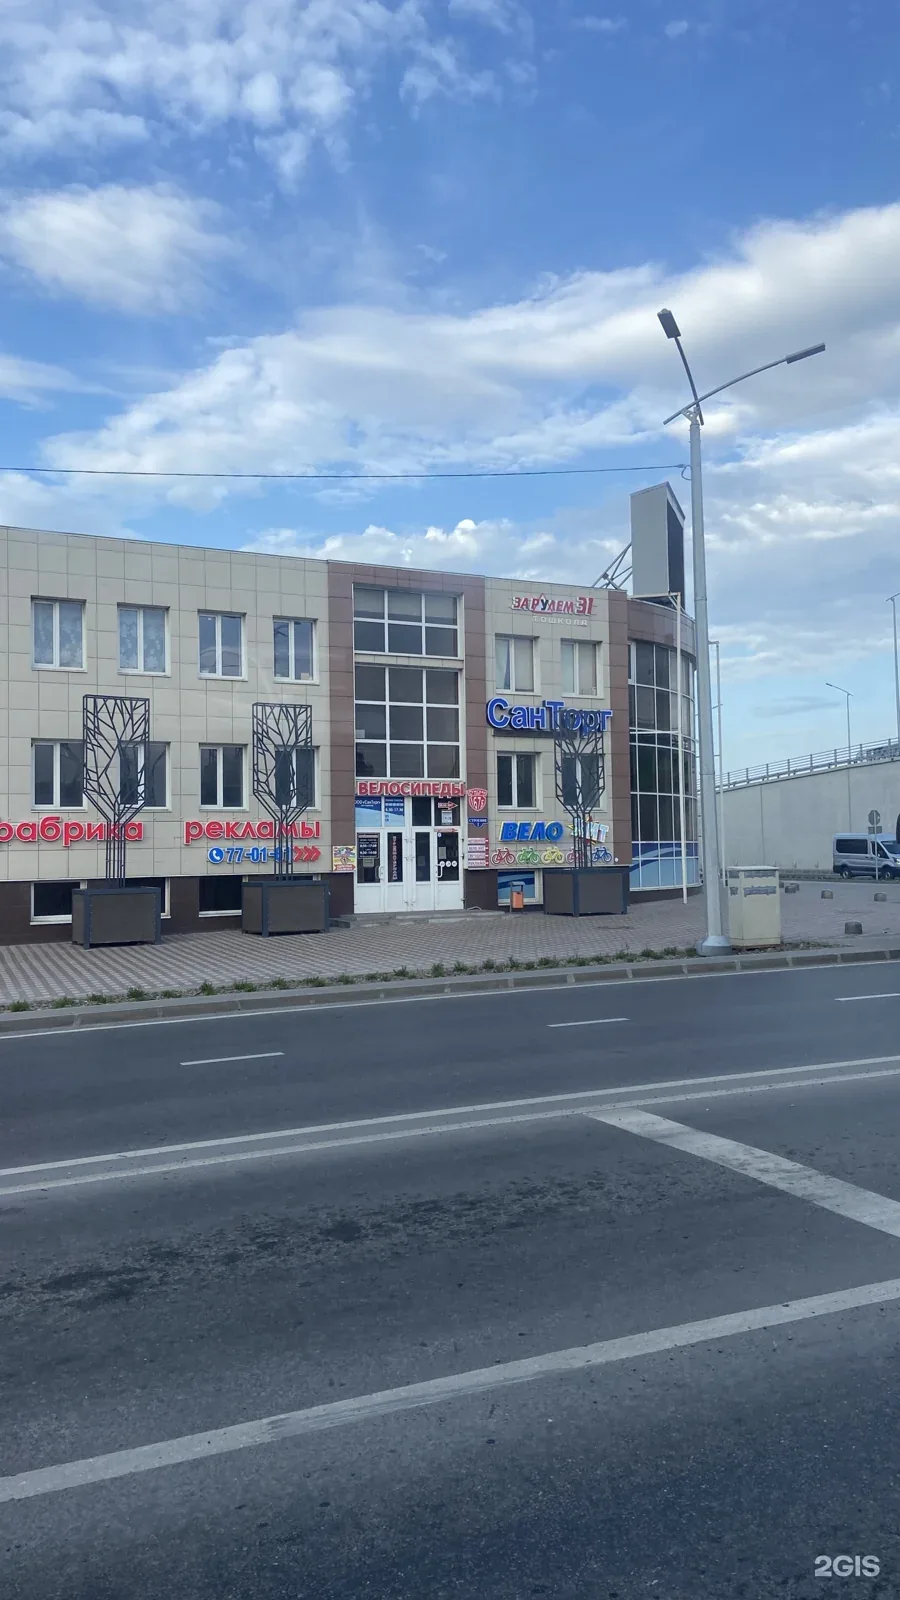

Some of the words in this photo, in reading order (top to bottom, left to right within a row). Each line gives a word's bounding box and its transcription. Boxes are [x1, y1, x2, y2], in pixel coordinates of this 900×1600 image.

[486, 697, 613, 739] СанТорг
[357, 781, 466, 799] ВЕЛОСИПЕДЫ
[184, 820, 321, 845] рекламы
[499, 820, 564, 842] ВЕЛО
